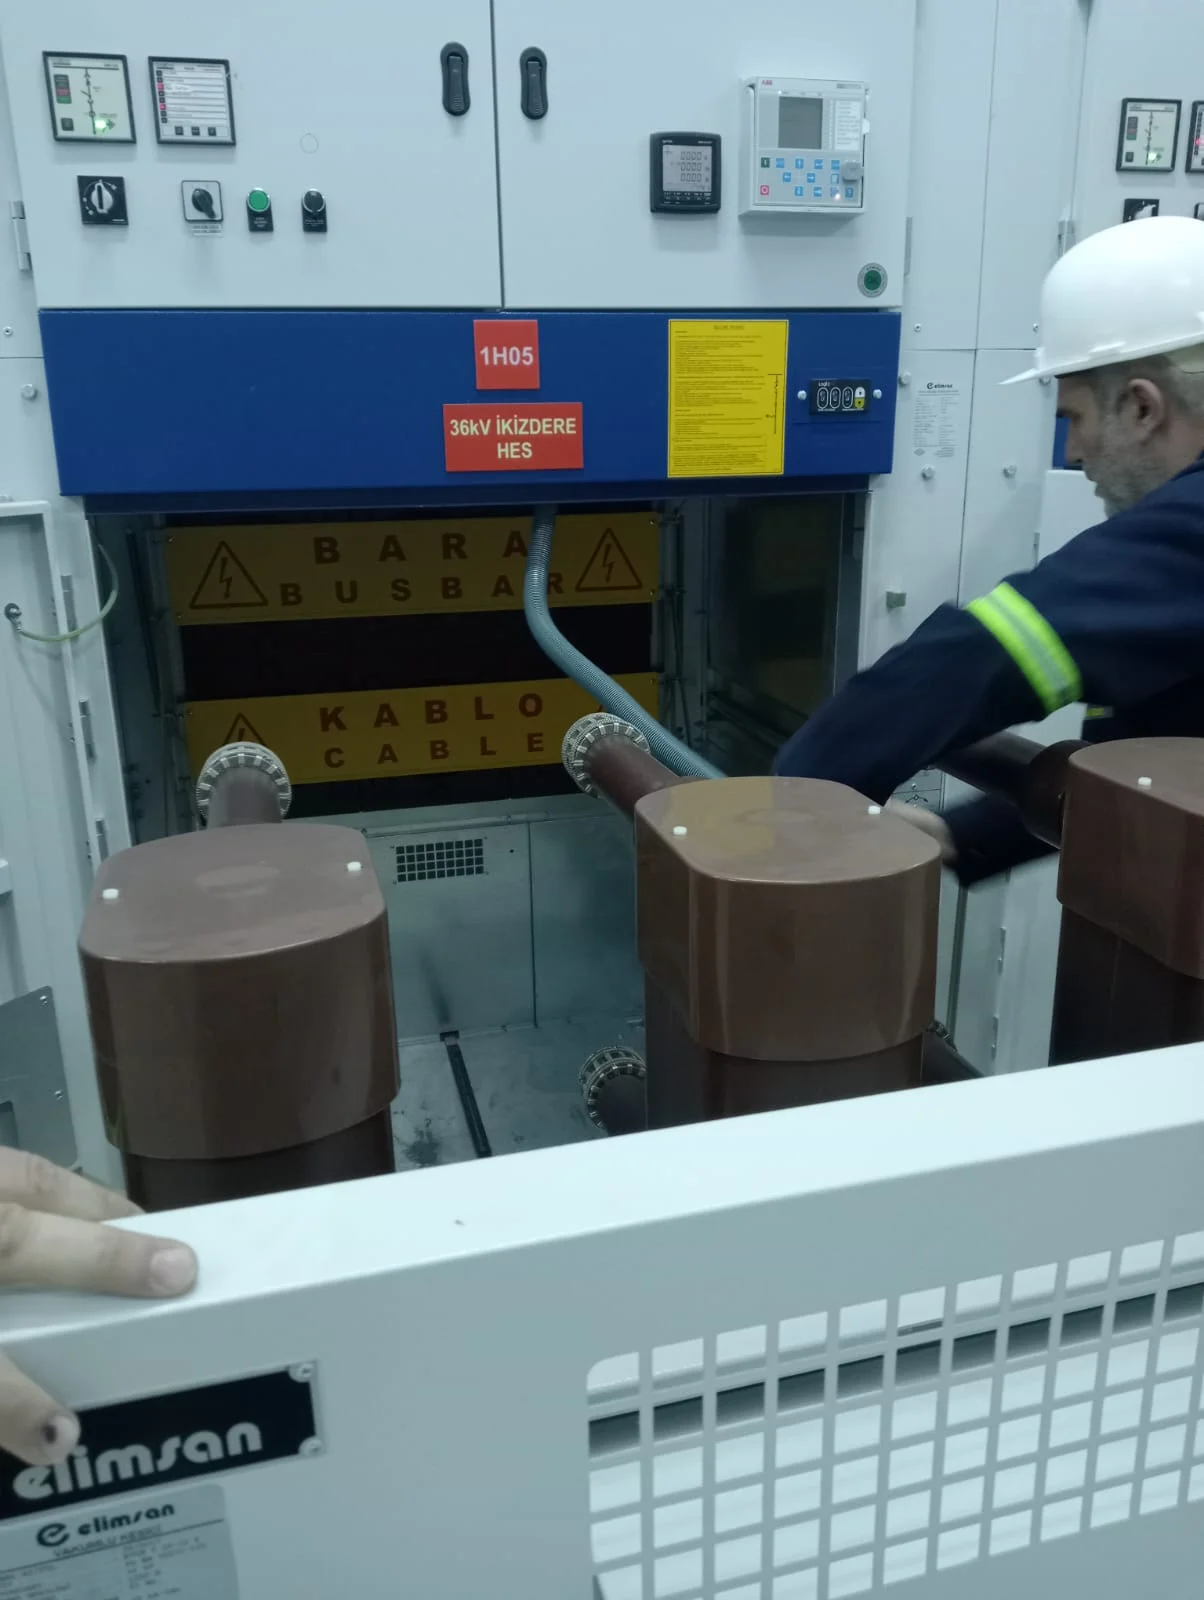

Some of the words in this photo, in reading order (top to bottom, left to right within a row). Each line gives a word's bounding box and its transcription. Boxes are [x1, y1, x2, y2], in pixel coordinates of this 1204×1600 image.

[479, 346, 534, 366] 1H05
[449, 418, 491, 437] 36kV
[496, 414, 577, 436] İKİZDERE
[496, 442, 533, 459] HES
[313, 531, 529, 565] BARA
[320, 693, 543, 732] KABLO
[324, 732, 544, 768] CABLE
[12, 1421, 263, 1500] elimsan
[77, 1503, 175, 1536] elimsan
